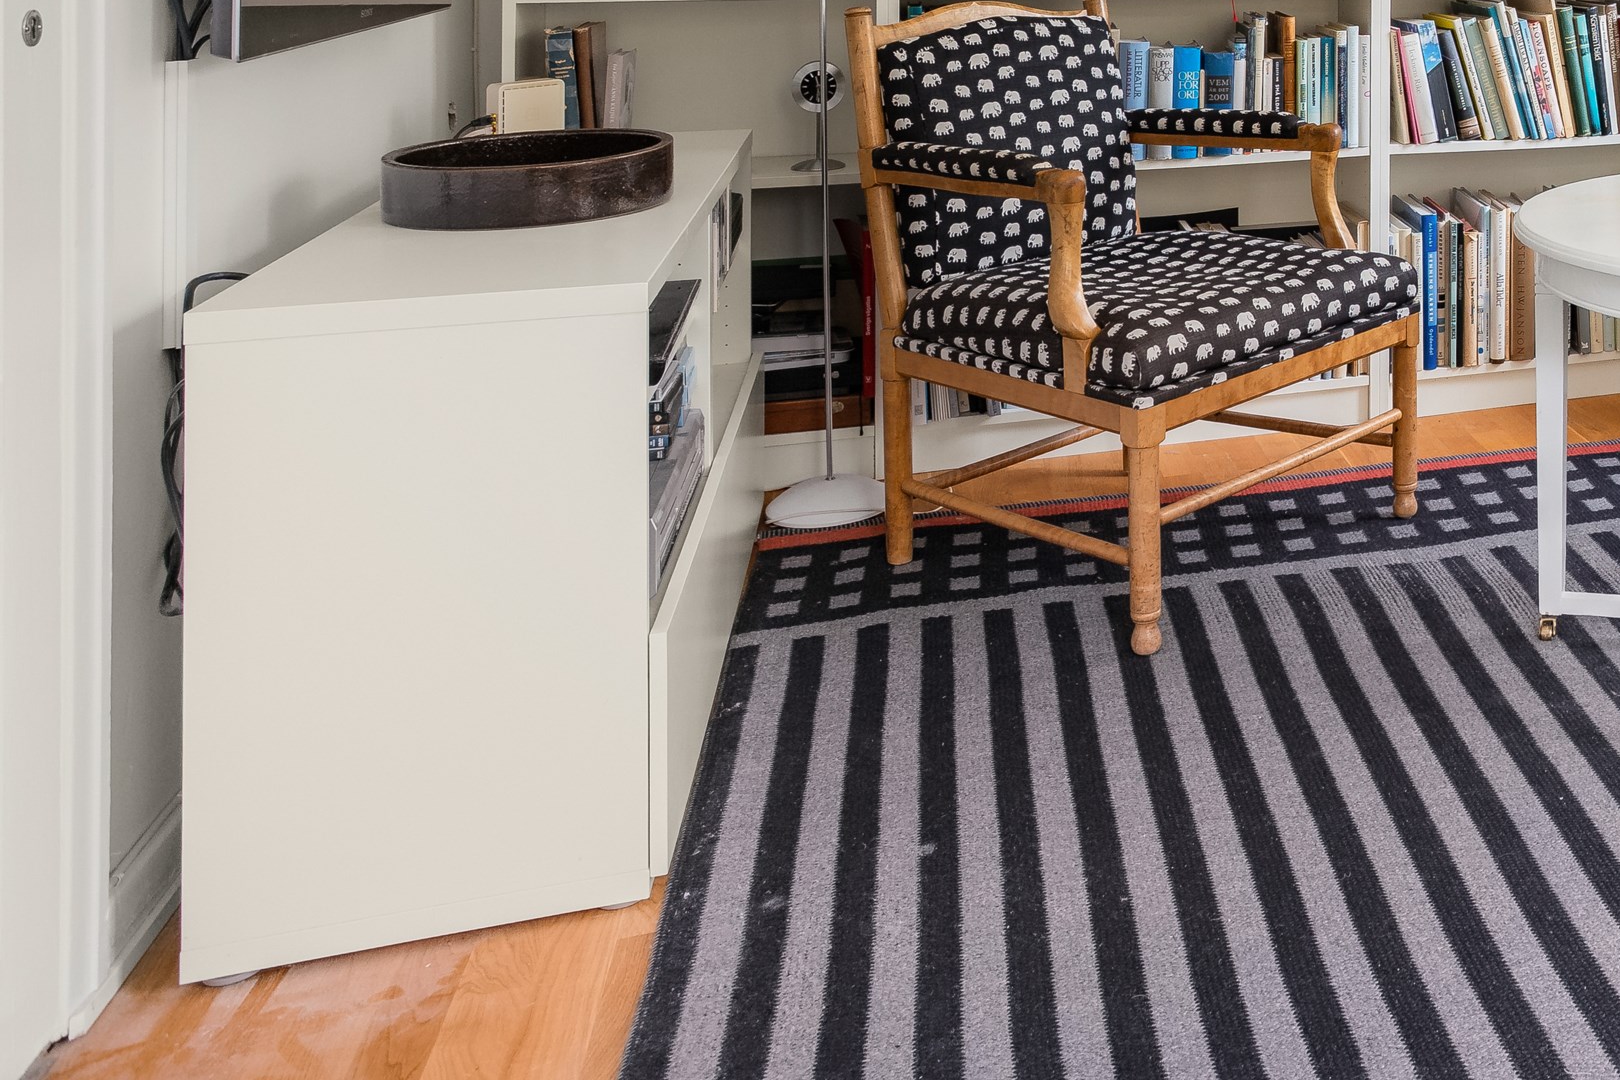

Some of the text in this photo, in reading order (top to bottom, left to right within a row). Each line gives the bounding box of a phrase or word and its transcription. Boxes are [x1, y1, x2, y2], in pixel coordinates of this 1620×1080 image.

[1533, 25, 1552, 91] TOWNSCAPE
[1610, 50, 1618, 73] visdom
[1134, 49, 1143, 98] LITTERATUR
[1178, 71, 1199, 80] ORD
[1178, 90, 1199, 100] ORD
[1179, 80, 1198, 90] FÖR
[1457, 89, 1467, 111] SPINDELN
[1495, 273, 1504, 307] Alla Tider
